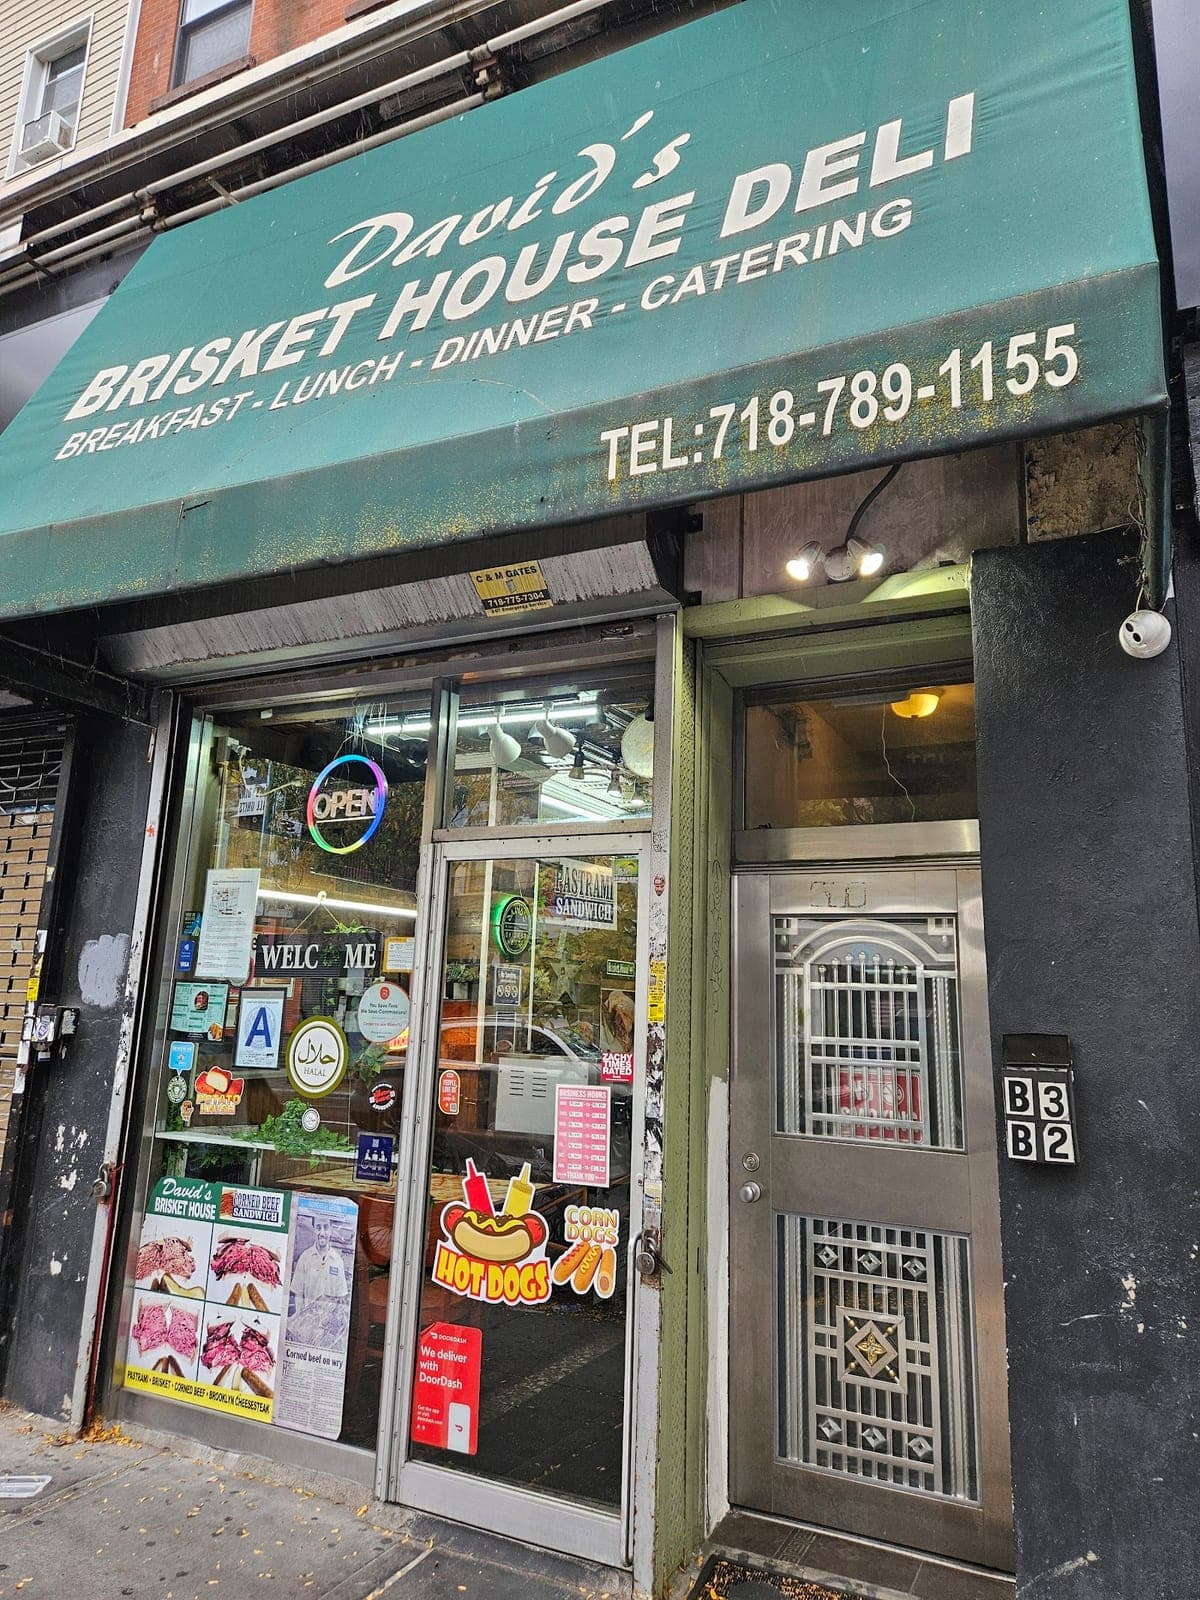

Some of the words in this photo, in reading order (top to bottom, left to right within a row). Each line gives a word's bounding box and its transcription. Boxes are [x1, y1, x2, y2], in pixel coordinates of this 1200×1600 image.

[325, 110, 691, 289] David's
[63, 292, 377, 422] BRISKET
[377, 191, 695, 342] HOUSE
[719, 92, 976, 239] DELI
[54, 390, 255, 462] BREAKFAST
[268, 350, 406, 411] LUNCH
[431, 298, 599, 370] DINNER
[640, 197, 914, 311] CATERING
[475, 575, 484, 583] C
[485, 574, 493, 582] &
[494, 571, 504, 580] M
[505, 565, 537, 578] GATES
[487, 591, 544, 608] 718-775-7304
[313, 788, 379, 820] OPEN
[555, 864, 613, 899] PASTRAMI
[556, 897, 614, 920] SANDWICH
[262, 943, 377, 970] WELCME
[245, 1007, 272, 1047] A
[298, 1038, 336, 1064] حلال
[602, 1053, 633, 1062] ZACHY
[303, 1067, 327, 1077] HALAL
[602, 1067, 632, 1075] RATED
[603, 1060, 632, 1068] TIMES
[162, 1178, 212, 1201] David's
[154, 1197, 189, 1217] BRISKET
[189, 1202, 216, 1220] HOUSE
[261, 1195, 281, 1210] BEEF
[232, 1208, 279, 1222] SANDWICH
[566, 1206, 618, 1229] CORN
[566, 1224, 618, 1245] DOGS
[436, 1246, 486, 1297] HOT
[487, 1260, 549, 1301] DOGS
[438, 1335, 467, 1344] DOORDASH
[286, 1349, 308, 1362] Corned
[308, 1352, 322, 1364] beef
[322, 1357, 331, 1365] on
[331, 1358, 344, 1369] wry
[421, 1345, 436, 1358] We
[437, 1348, 468, 1363] deliver
[420, 1361, 439, 1372] with
[127, 1370, 149, 1382] PASTRAMI
[151, 1376, 171, 1389] BRISKET
[174, 1381, 193, 1395] CORNED
[193, 1386, 205, 1398] BEEF
[208, 1389, 235, 1405] BROOKLYN
[234, 1396, 270, 1413] CHEESESTEAK
[420, 1372, 463, 1390] DoorDash
